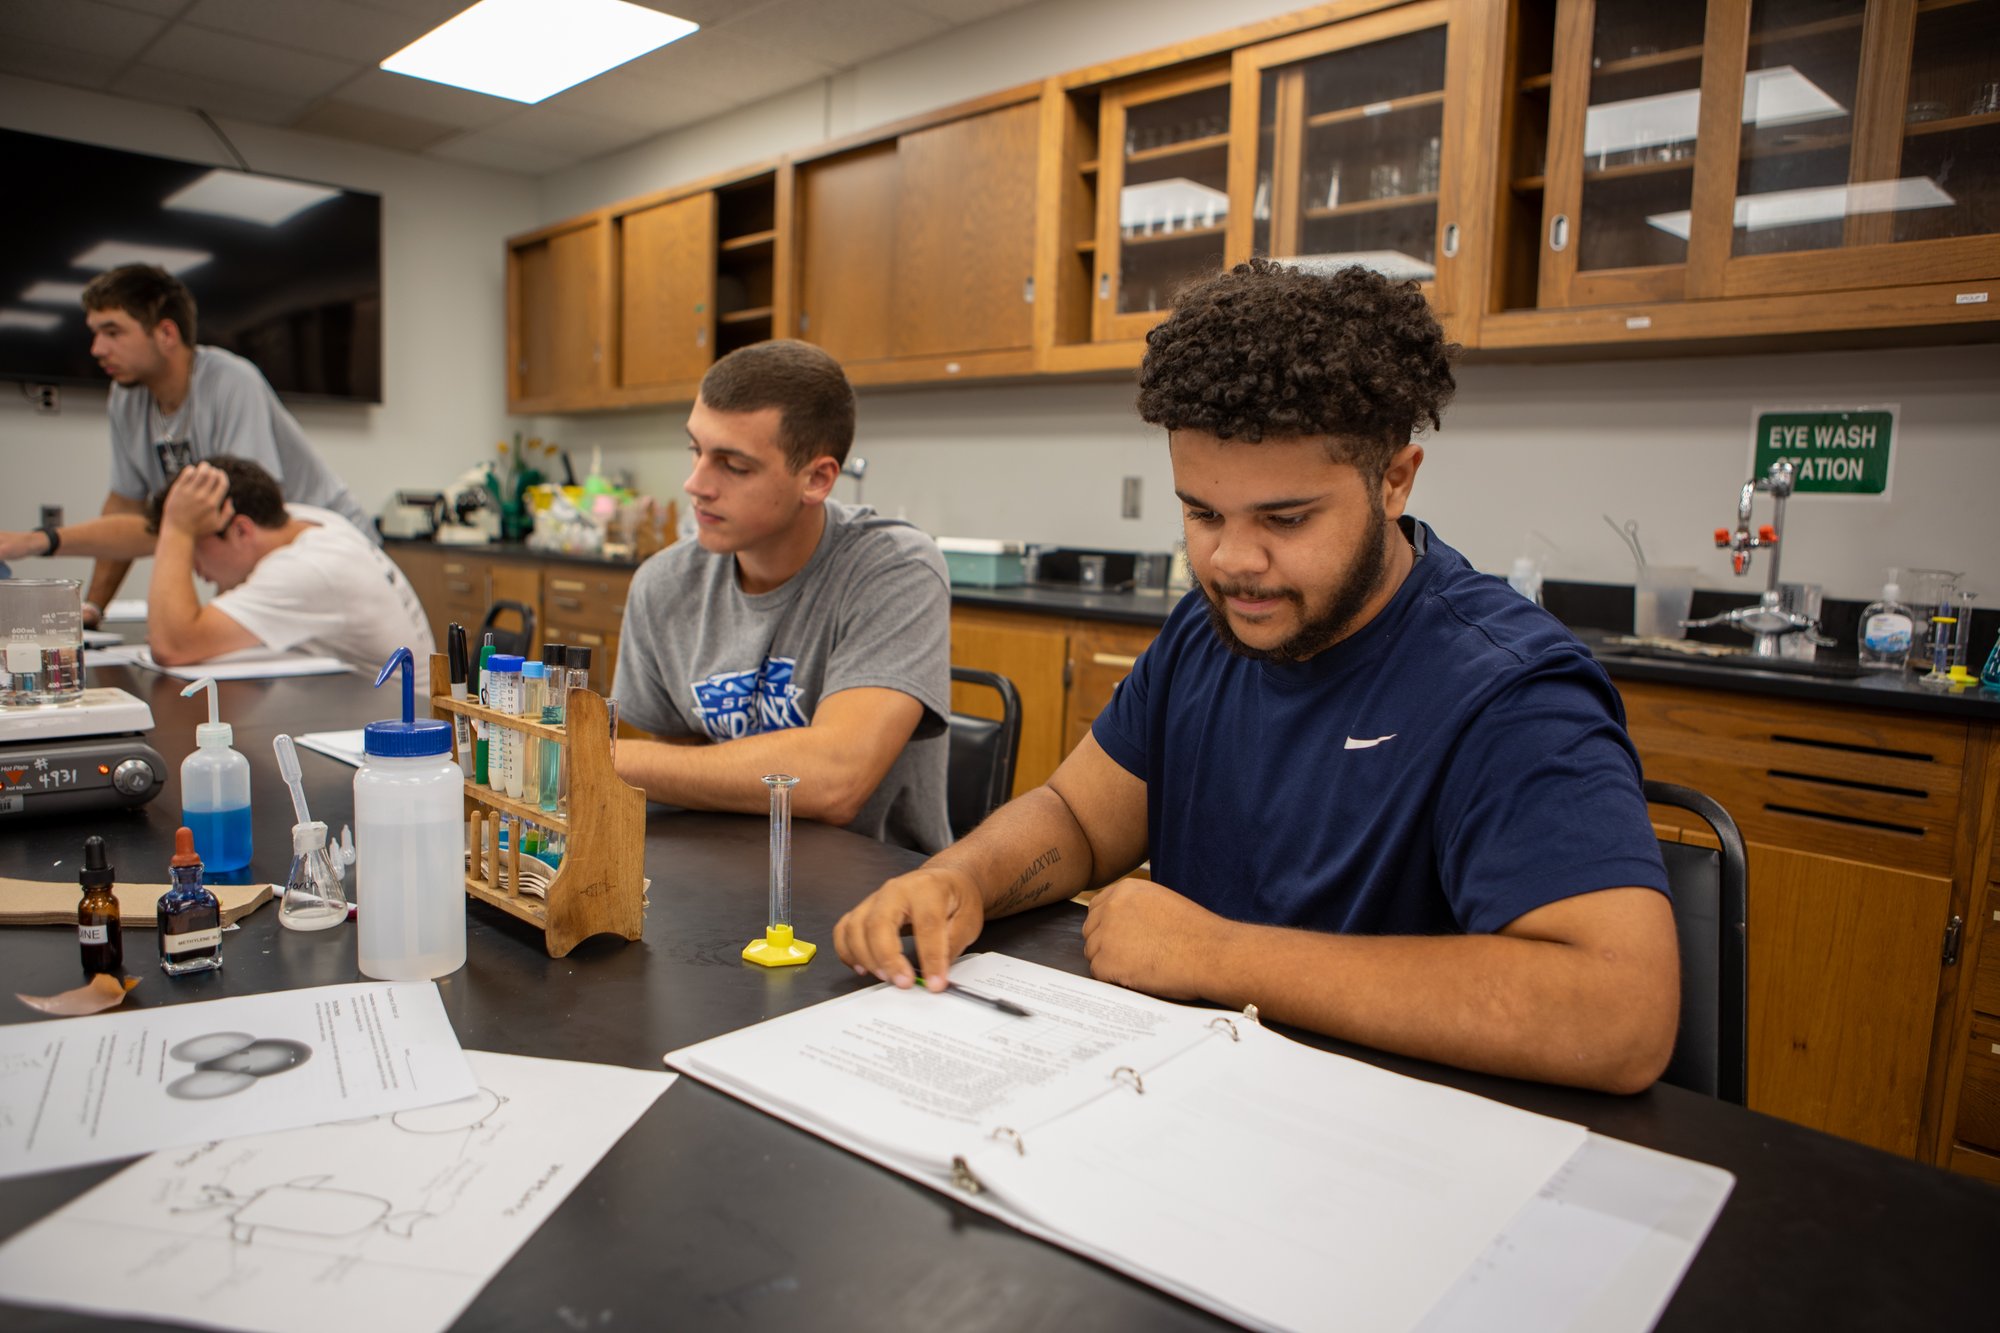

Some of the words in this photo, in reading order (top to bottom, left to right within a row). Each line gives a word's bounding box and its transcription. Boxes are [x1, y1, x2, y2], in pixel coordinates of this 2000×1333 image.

[1769, 426, 1809, 449] EYE
[1814, 425, 1877, 449] WASH
[1776, 456, 1864, 480] TATION
[38, 768, 77, 789] 4931
[286, 879, 319, 891] tarch
